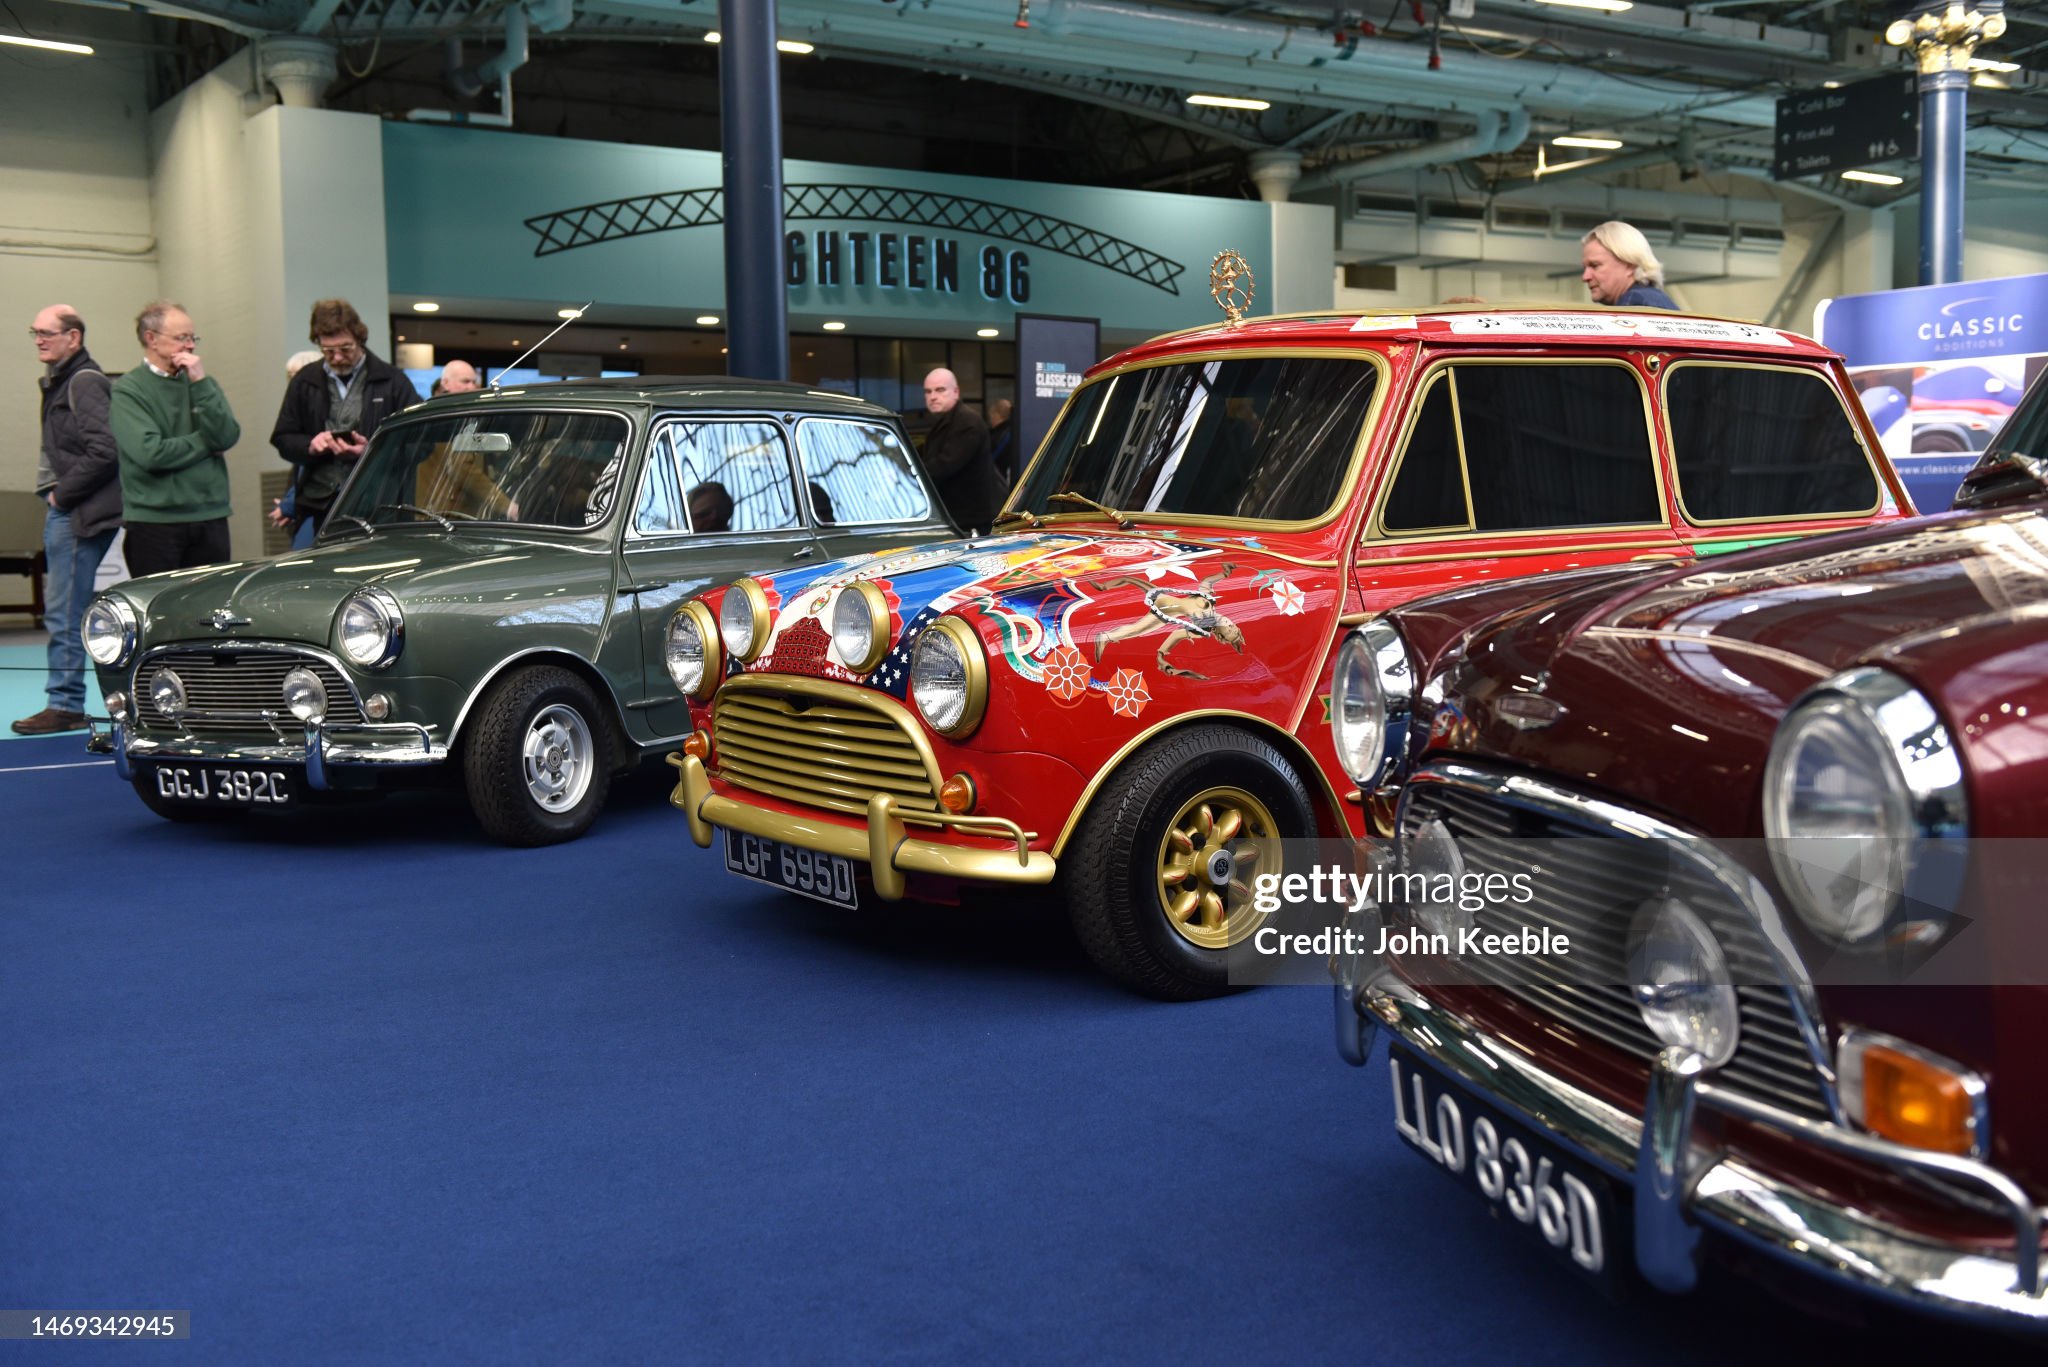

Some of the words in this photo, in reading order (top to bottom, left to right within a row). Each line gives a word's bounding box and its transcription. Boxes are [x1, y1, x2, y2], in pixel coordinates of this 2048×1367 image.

[1796, 154, 1831, 169] Toilets
[785, 230, 959, 293] GHTEEN
[980, 245, 1030, 305] 86
[1917, 314, 2024, 340] CLASSIC
[1934, 337, 2005, 352] ADDITIONS
[156, 766, 209, 800] GGJ
[215, 769, 289, 803] 382C
[726, 827, 774, 877] LGF
[780, 843, 851, 901] 695D
[1390, 1057, 1467, 1174] LLO
[1473, 1115, 1605, 1273] 836D
